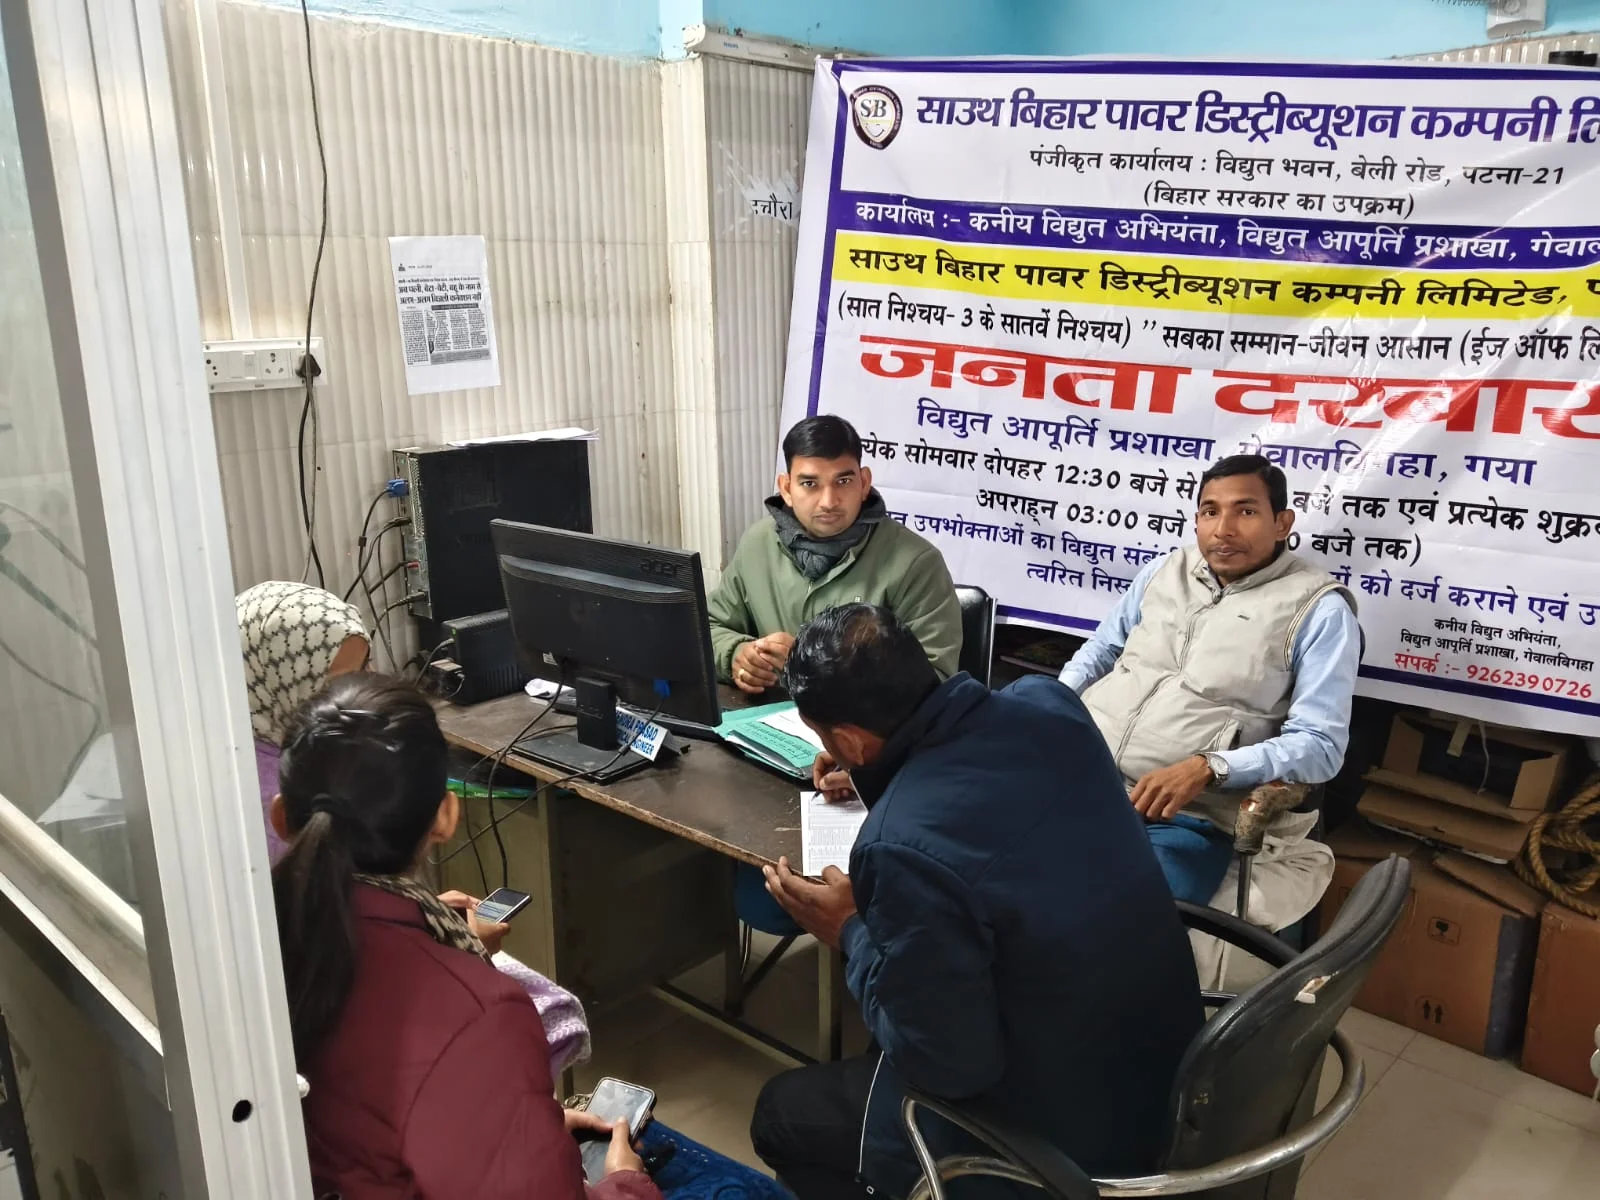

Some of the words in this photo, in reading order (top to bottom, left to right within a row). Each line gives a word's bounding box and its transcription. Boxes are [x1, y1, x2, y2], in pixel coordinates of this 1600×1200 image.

[860, 99, 887, 117] SB
[916, 96, 1004, 128] साउथ
[1010, 87, 1101, 130] बिहार
[1105, 98, 1188, 132] पावर
[1195, 90, 1406, 150] डिस्ट्रीब्यूशन
[1411, 96, 1561, 142] कम्पनी
[1030, 144, 1101, 173] पंजीकृत
[1110, 147, 1192, 172] कार्यालय
[1215, 150, 1274, 181] विद्युत
[1282, 157, 1341, 181] भवन,
[1351, 155, 1397, 180] बेली
[1406, 157, 1452, 186] रोड,
[1463, 165, 1564, 185] पटना-21
[856, 198, 935, 228] कार्यालय
[969, 209, 1034, 236] कनीय
[1042, 205, 1106, 243] विद्युत
[1115, 213, 1226, 248] अभियंता,
[1237, 218, 1309, 252] विद्युत
[1317, 226, 1409, 260] आपूर्ति
[1414, 234, 1518, 261] प्रशाखा,
[1144, 181, 1207, 208] (बिहार
[1217, 188, 1290, 211] सरकार
[1296, 192, 1326, 213] का
[1333, 193, 1415, 220] उपक्रम)
[849, 247, 927, 275] साउथ
[935, 250, 1006, 284] बिहार
[1015, 263, 1090, 289] पावर
[1100, 260, 1282, 305] डिस्ट्रीब्यूशन
[1292, 278, 1406, 306] कम्पनी
[1416, 278, 1567, 307] लिमिटेड,
[838, 290, 880, 321] (सात
[887, 295, 955, 327] निश्चय-
[961, 307, 974, 328] 3
[980, 303, 995, 332] के
[1000, 306, 1051, 338] सातवें
[1057, 308, 1131, 349] निश्चय)
[1162, 324, 1224, 353] सबका
[1230, 325, 1370, 360] सम्मान-जीवन
[1376, 334, 1452, 362] आसान
[1460, 327, 1510, 366] (ईज
[1514, 327, 1570, 362] ऑफ
[859, 334, 1192, 415] जनता
[917, 397, 993, 438] विद्युत
[1002, 415, 1100, 453] आपूर्ति
[1463, 454, 1538, 486] गया
[904, 437, 978, 471] सोमवार
[984, 447, 1046, 481] दोपहर
[1055, 462, 1121, 491] 12:30
[1130, 468, 1169, 498] बजे
[1175, 472, 1197, 501] से
[1343, 494, 1389, 519] तक
[1398, 490, 1439, 525] एवं
[1448, 495, 1528, 531] प्रत्येक
[1066, 502, 1139, 530] 03:00
[1147, 509, 1187, 539] बजे
[1312, 527, 1355, 557] बजे
[1364, 532, 1423, 568] तक)
[914, 512, 1024, 546] उपभोक्ताओं
[1031, 531, 1055, 552] का
[1062, 531, 1116, 565] विद्युत
[1360, 569, 1392, 597] को
[1400, 575, 1443, 604] दर्ज
[1448, 584, 1518, 615] कराने
[1528, 592, 1569, 623] एवं
[1027, 561, 1085, 588] त्वरित
[1400, 628, 1432, 650] विद्युत
[1435, 637, 1473, 654] आपूर्ति
[1434, 617, 1468, 634] कनीय
[1471, 620, 1504, 641] विद्युत
[1507, 627, 1562, 649] अभियंता,
[1394, 648, 1441, 674] संपर्क
[1467, 663, 1593, 699] 9262390726
